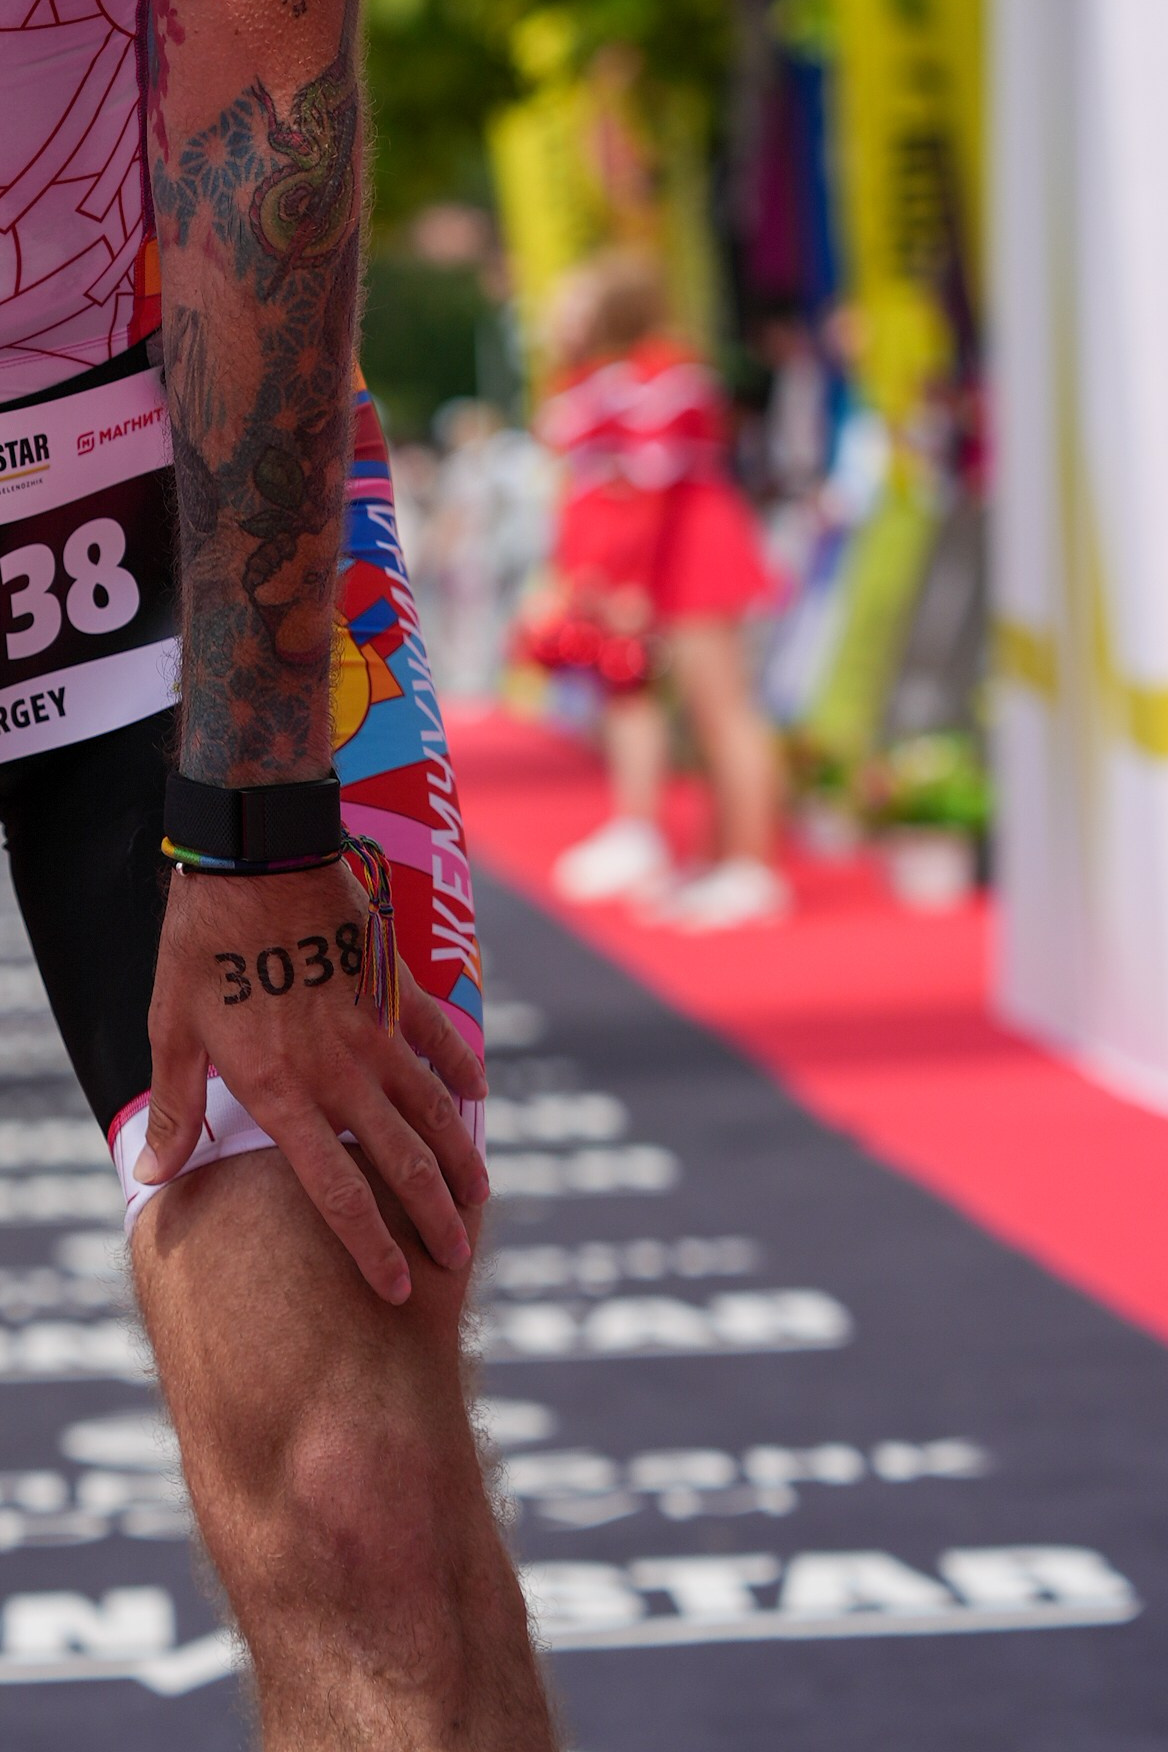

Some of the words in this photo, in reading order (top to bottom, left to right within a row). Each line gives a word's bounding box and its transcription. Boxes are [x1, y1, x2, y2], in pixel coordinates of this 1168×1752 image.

[99, 406, 164, 445] МАГНИТ
[214, 922, 363, 1006] 3038
[520, 1545, 1136, 1633] STAR
